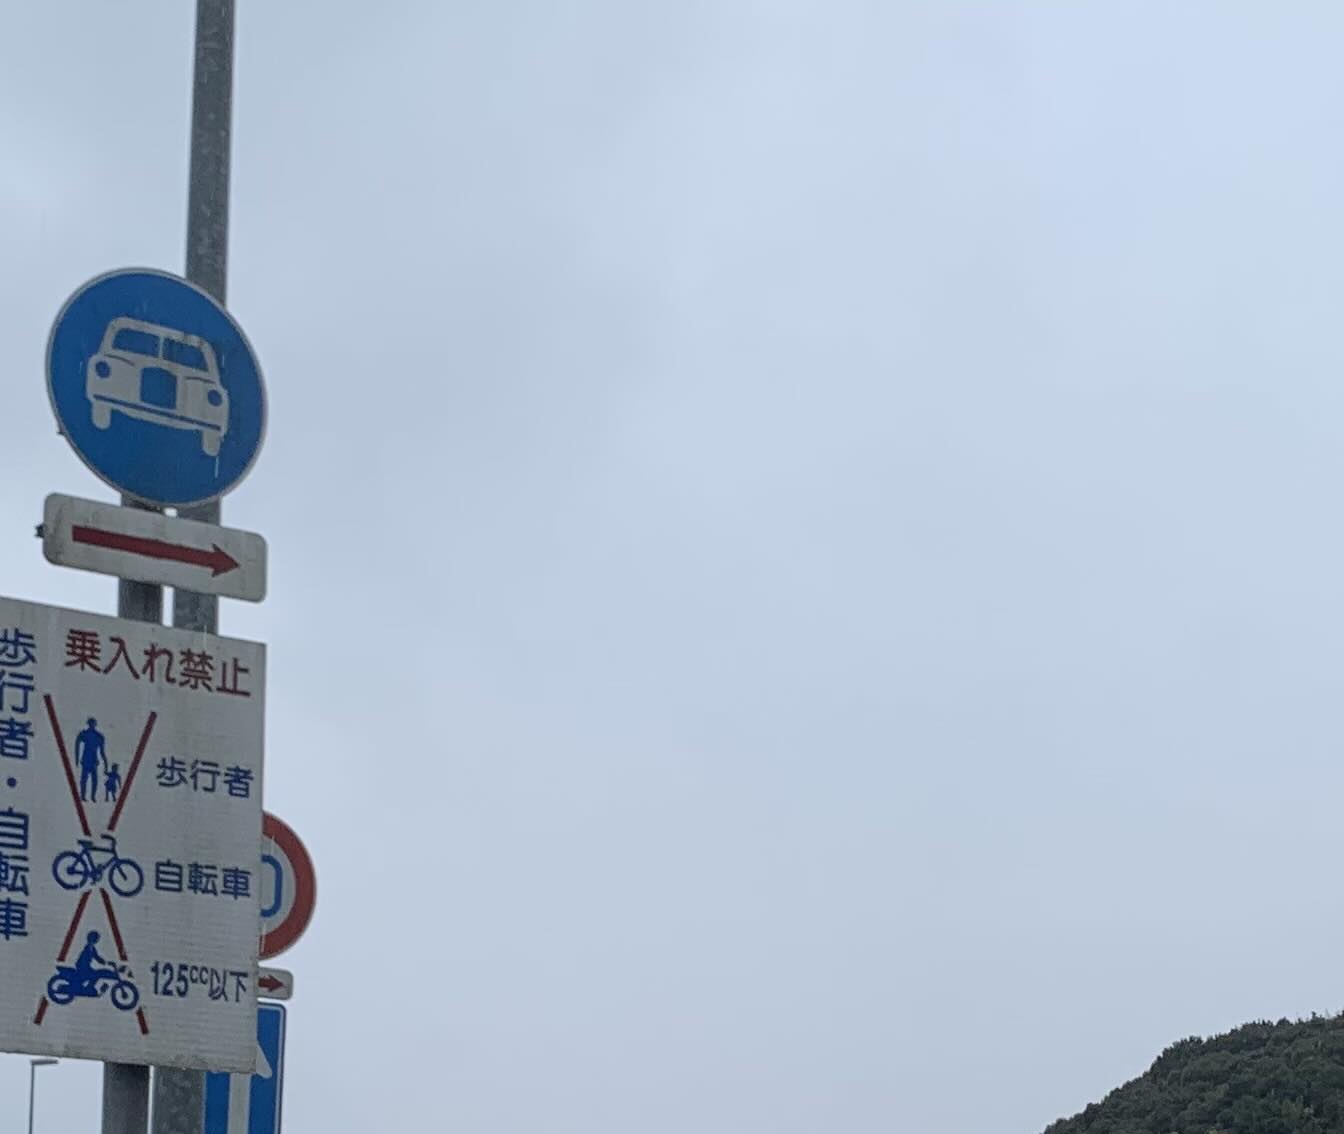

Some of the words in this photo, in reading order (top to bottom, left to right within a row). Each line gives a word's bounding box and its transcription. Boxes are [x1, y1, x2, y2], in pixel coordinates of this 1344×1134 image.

[65, 629, 251, 698] 乗入れ禁止
[156, 757, 254, 798] 歩行者
[155, 859, 252, 901] 自転車
